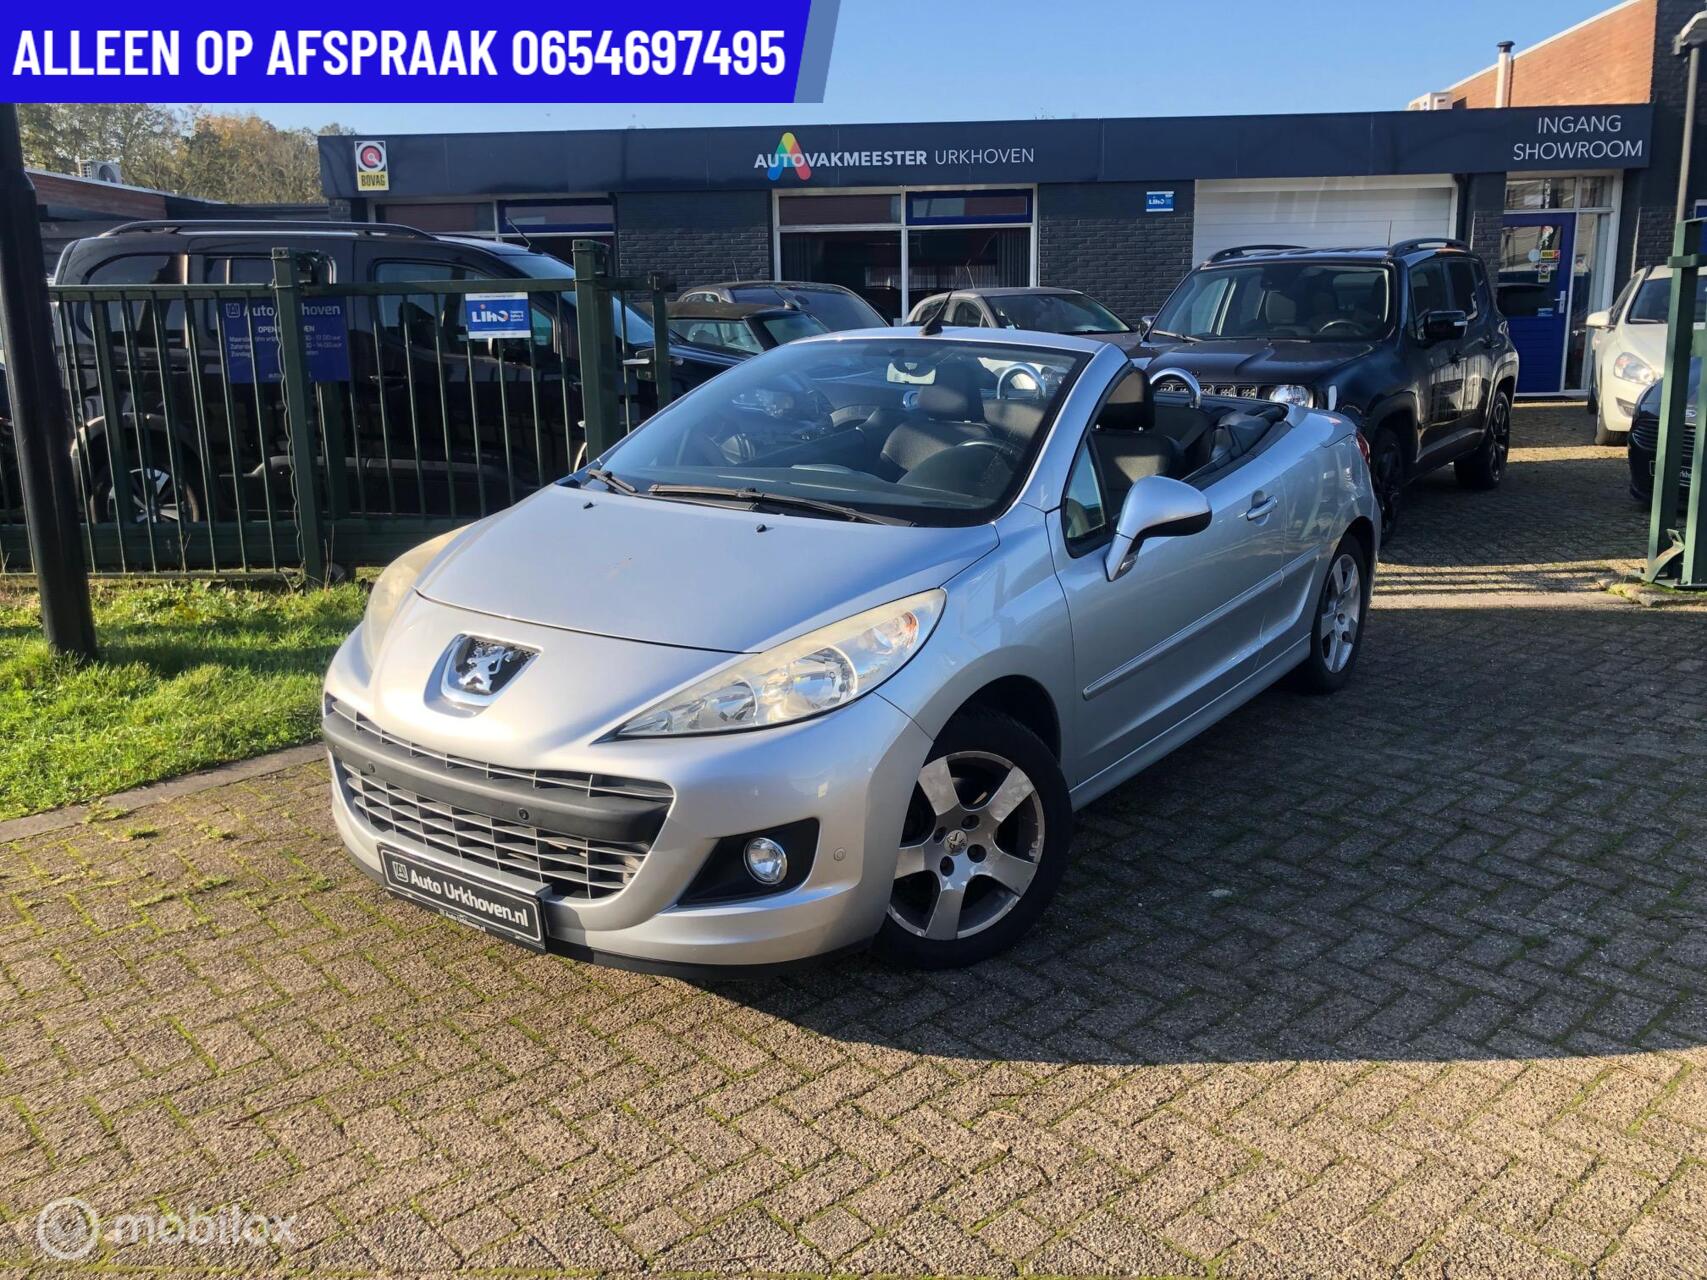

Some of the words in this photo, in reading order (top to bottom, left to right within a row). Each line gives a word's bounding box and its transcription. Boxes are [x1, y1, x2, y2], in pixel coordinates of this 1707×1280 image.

[1538, 114, 1622, 134] INGANG
[754, 150, 928, 169] AUTOVAKMEESTER
[935, 147, 1035, 165] URKHOVEN
[1513, 140, 1643, 160] SHOWROOM
[360, 174, 386, 187] BOVAG
[410, 869, 442, 894] Auto
[444, 881, 529, 927] Urkhoven.nl
